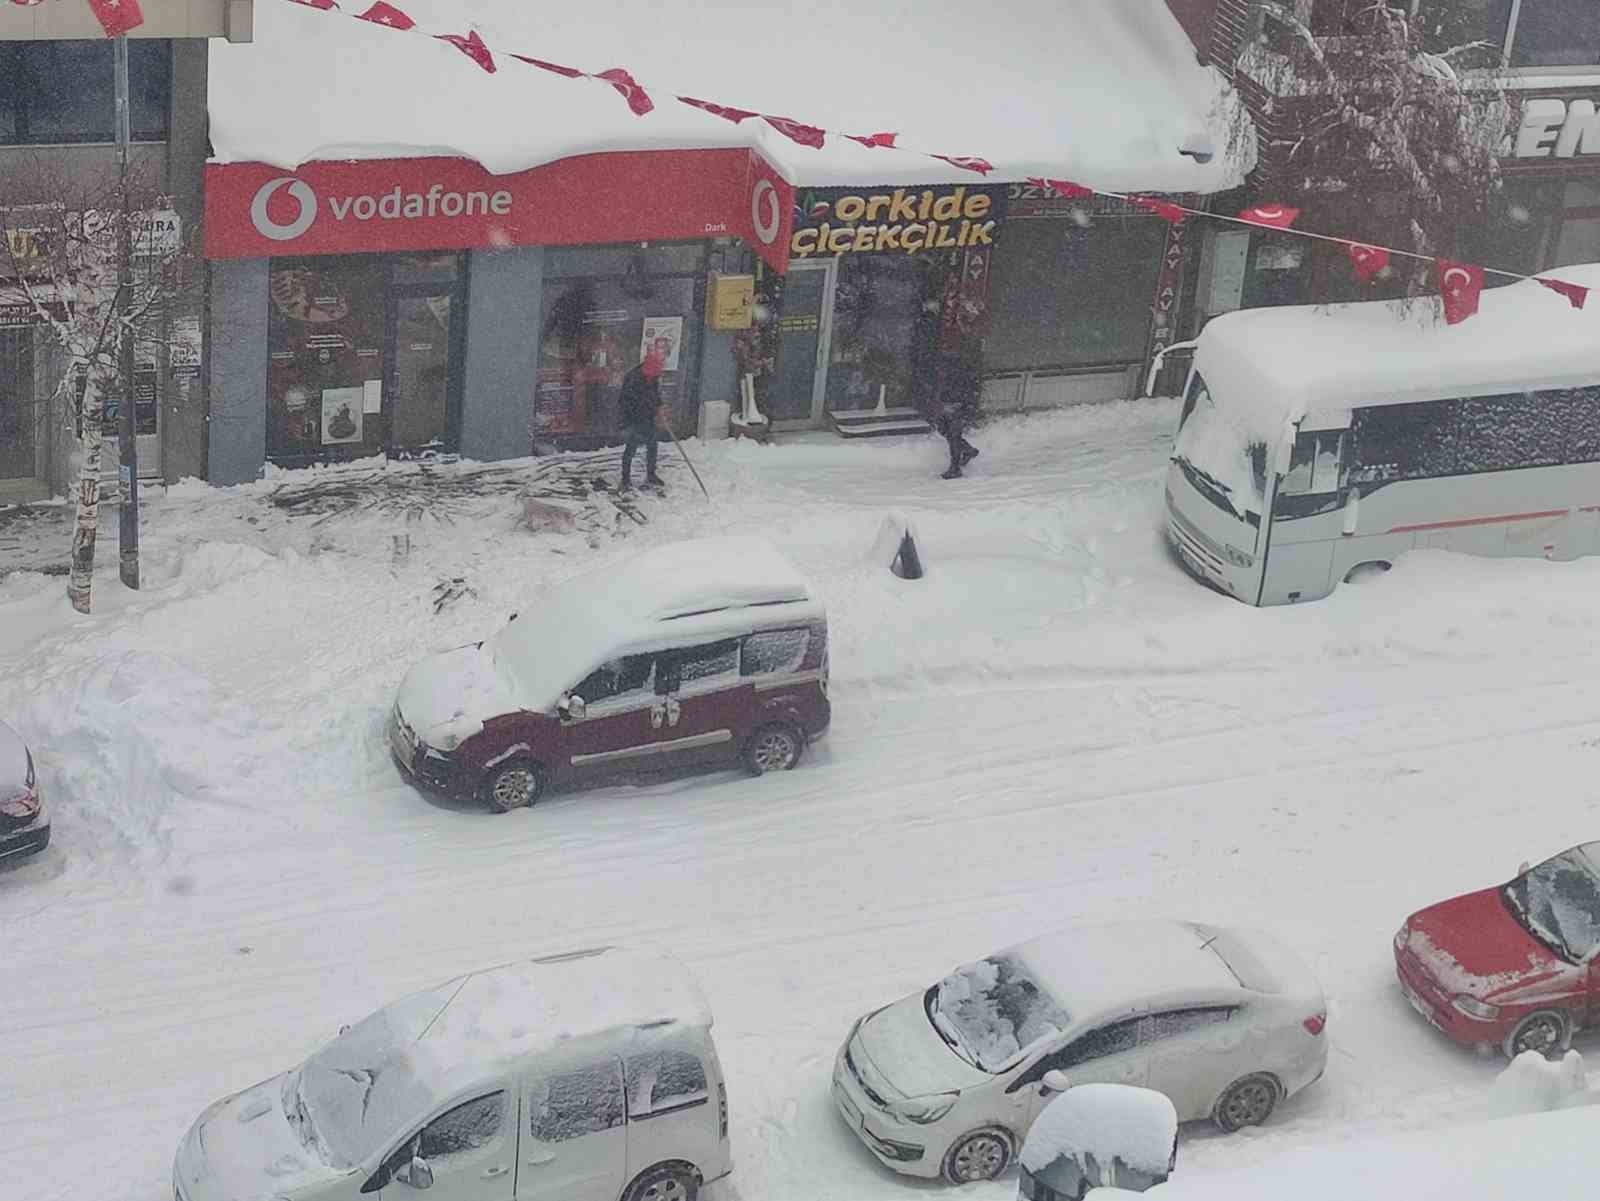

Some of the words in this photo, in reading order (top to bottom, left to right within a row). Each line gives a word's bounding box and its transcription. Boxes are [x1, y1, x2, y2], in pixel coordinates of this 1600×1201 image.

[328, 184, 512, 220] vodafone
[835, 188, 992, 222] orkide
[1153, 328, 1169, 352] BA
